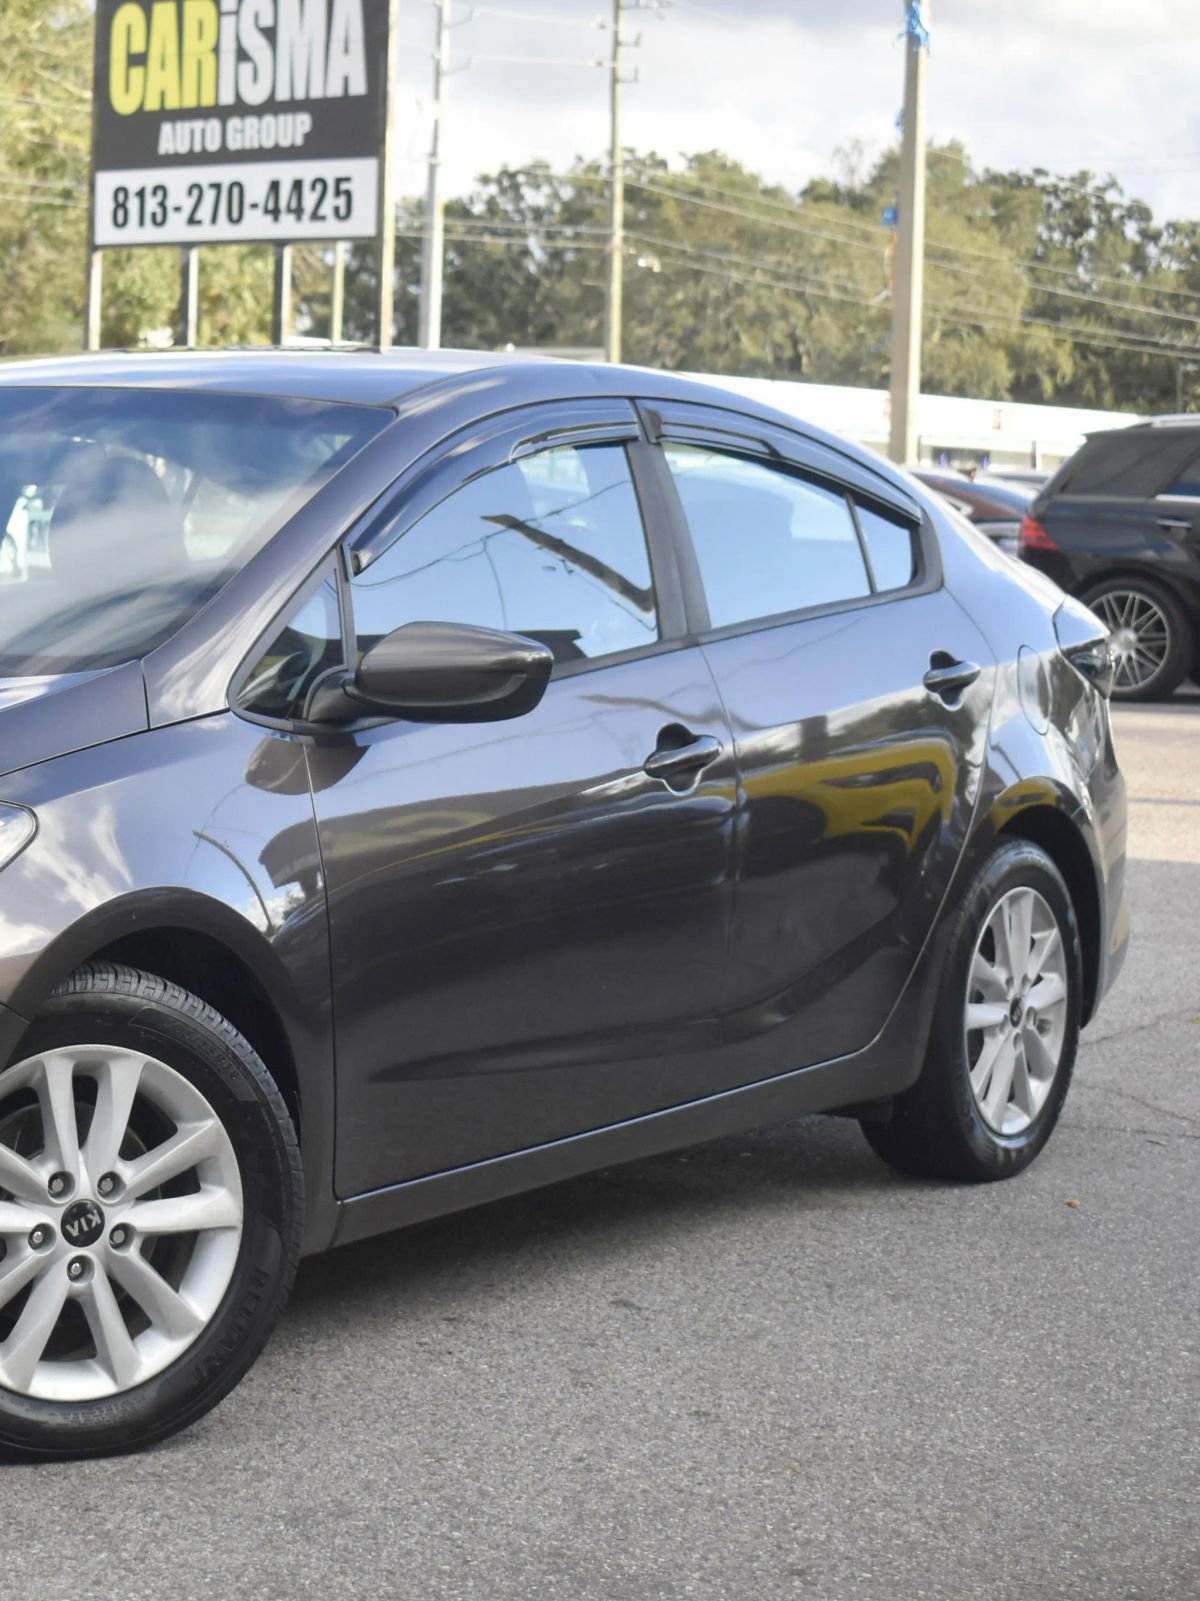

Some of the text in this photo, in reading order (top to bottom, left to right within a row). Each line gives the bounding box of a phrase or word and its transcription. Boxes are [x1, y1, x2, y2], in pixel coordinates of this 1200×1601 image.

[109, 0, 367, 115] CARiSMA
[158, 112, 312, 154] AUTO GROUP
[112, 177, 352, 228] 813-270-4425
[64, 1208, 102, 1238] KIA
